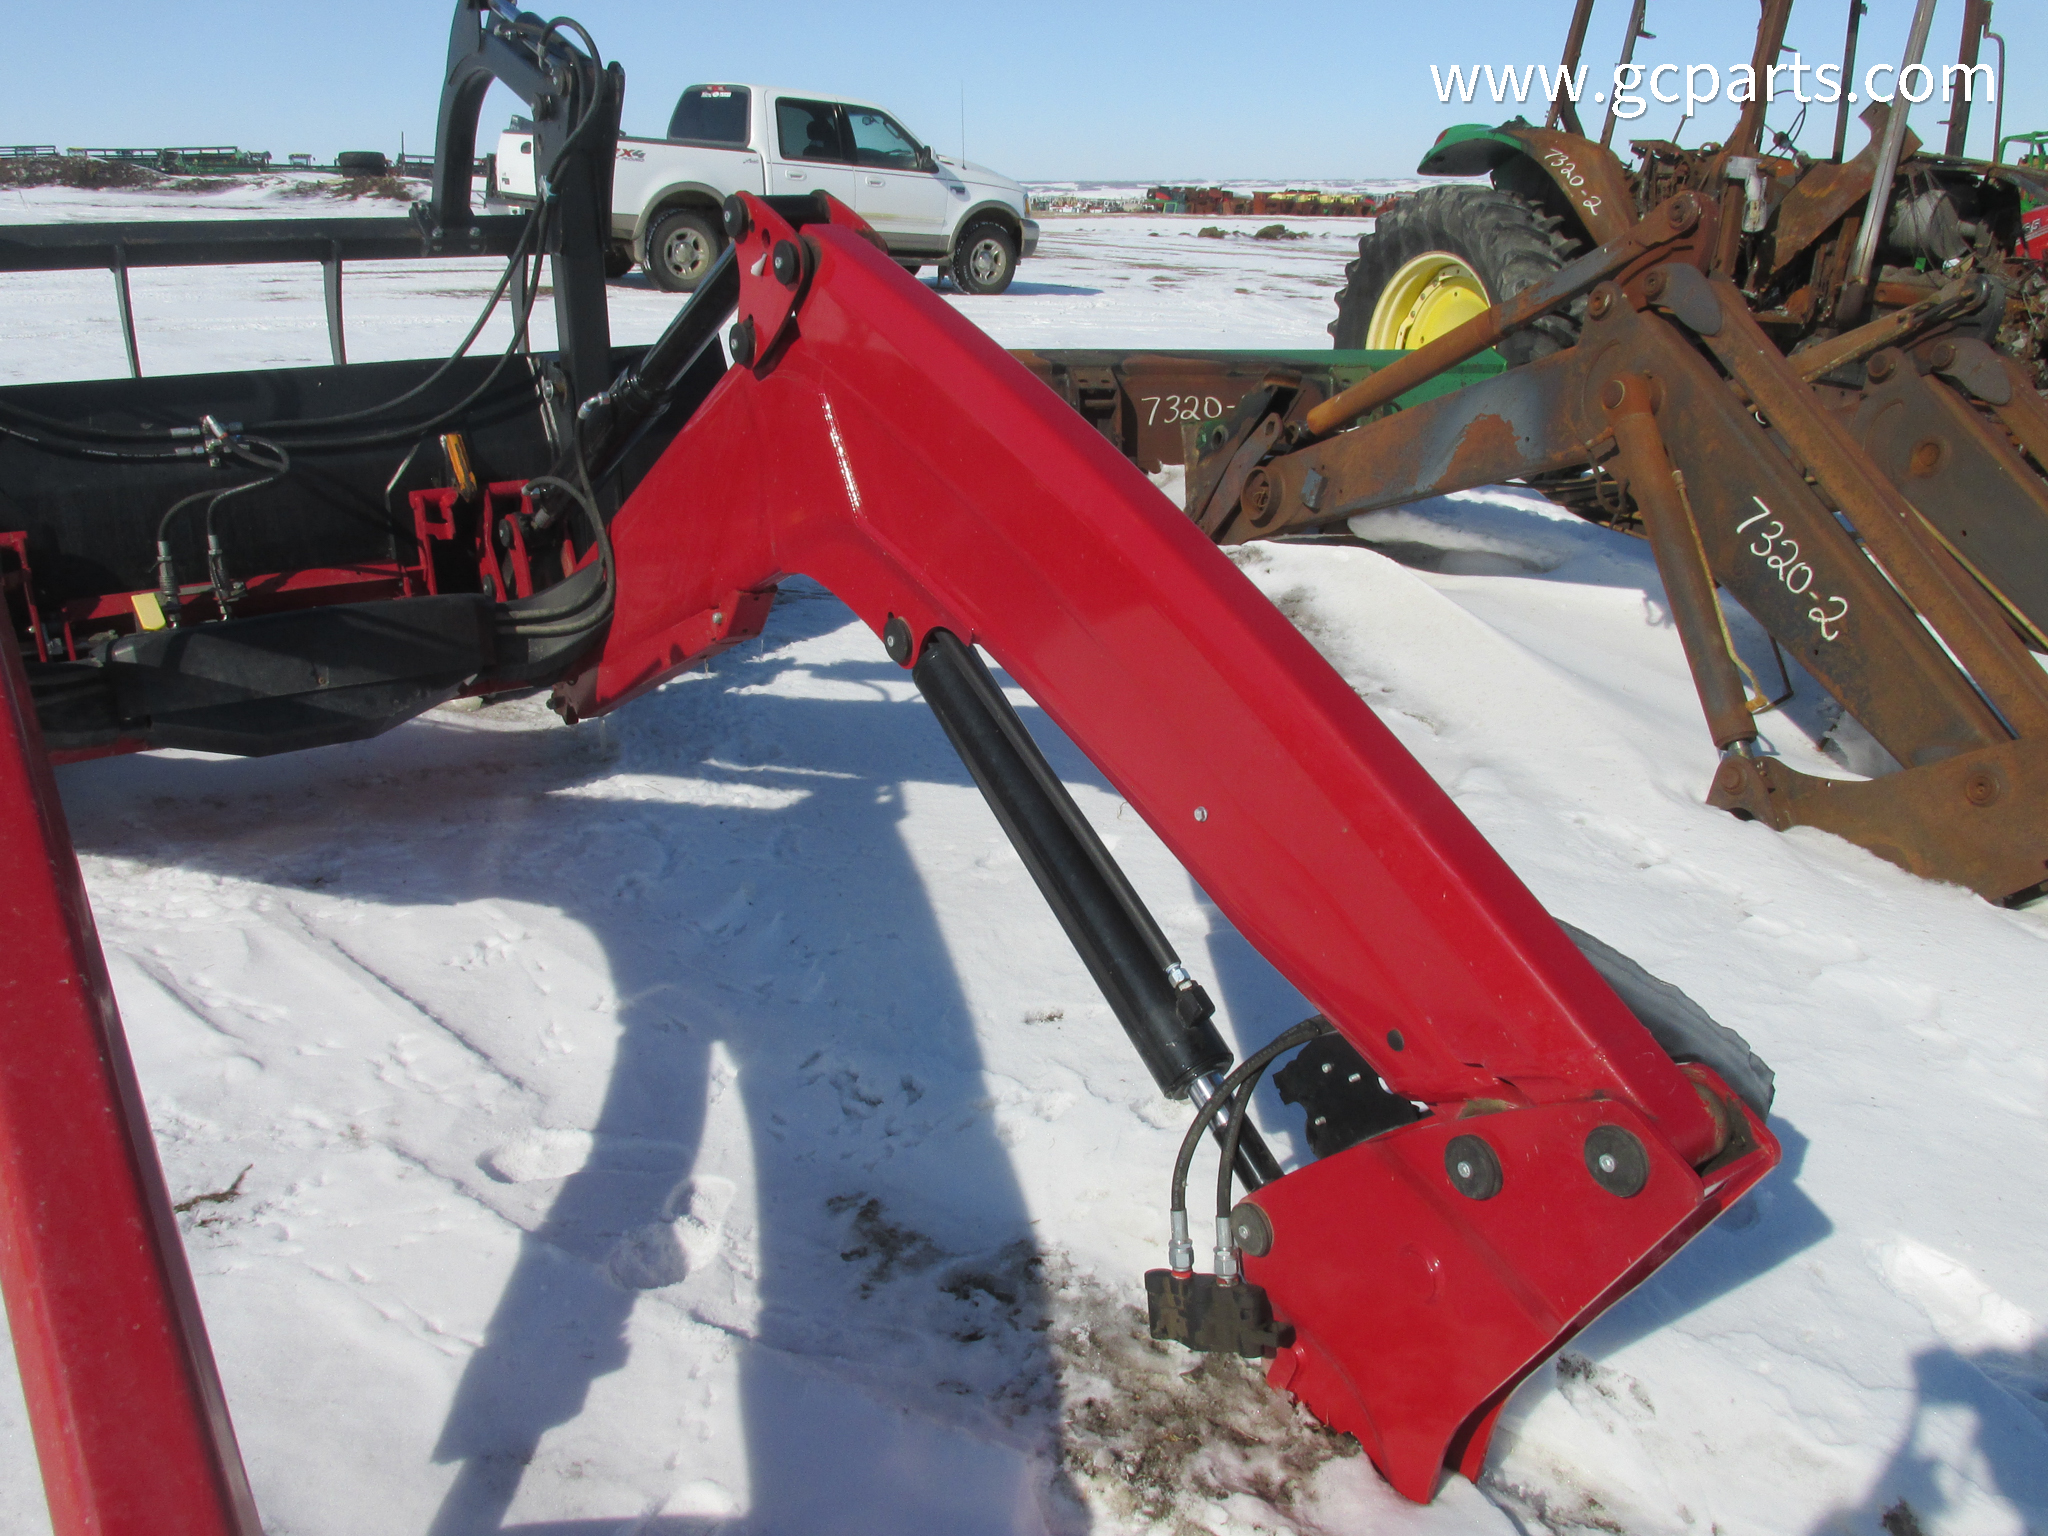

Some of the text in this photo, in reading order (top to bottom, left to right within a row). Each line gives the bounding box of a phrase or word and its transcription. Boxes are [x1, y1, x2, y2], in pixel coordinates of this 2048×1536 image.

[1544, 148, 1602, 216] 7320-2
[1141, 395, 1246, 426] 7320-
[1736, 496, 1848, 641] 7320-2
